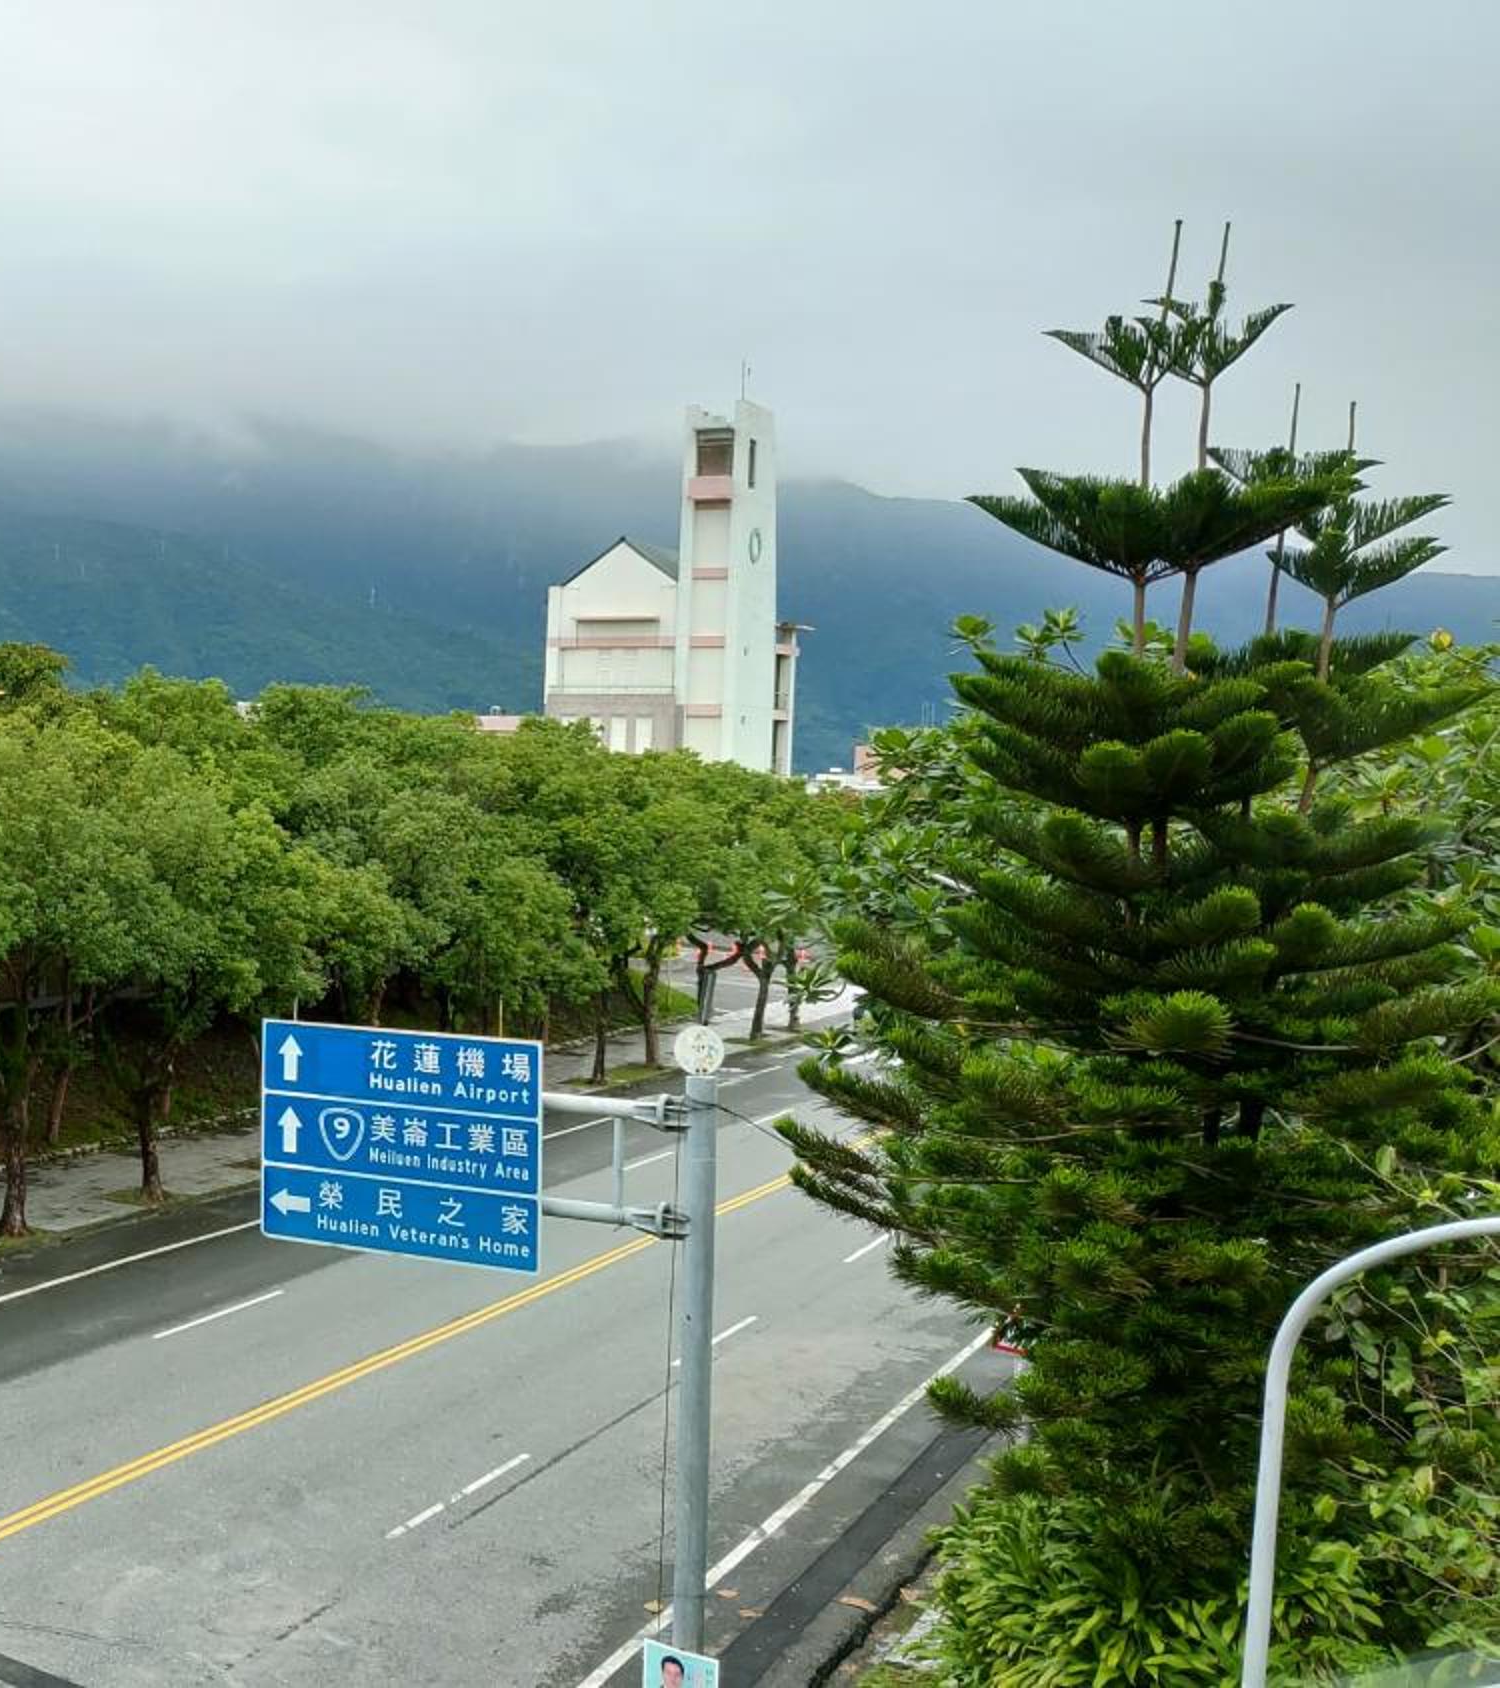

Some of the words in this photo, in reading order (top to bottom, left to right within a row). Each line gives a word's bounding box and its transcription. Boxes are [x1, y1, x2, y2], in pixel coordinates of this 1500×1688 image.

[371, 1040, 531, 1083] 花蓮機場
[369, 1073, 442, 1096] Hualien
[453, 1083, 530, 1105] Airport
[333, 1117, 351, 1139] 9
[370, 1113, 530, 1158] 美崙工業區
[427, 1154, 488, 1179] Industry
[495, 1162, 530, 1182] Area
[318, 1180, 529, 1236] 榮民之家
[317, 1214, 379, 1237] Hualien
[389, 1225, 470, 1250] Veteran's
[479, 1236, 530, 1258] Home
